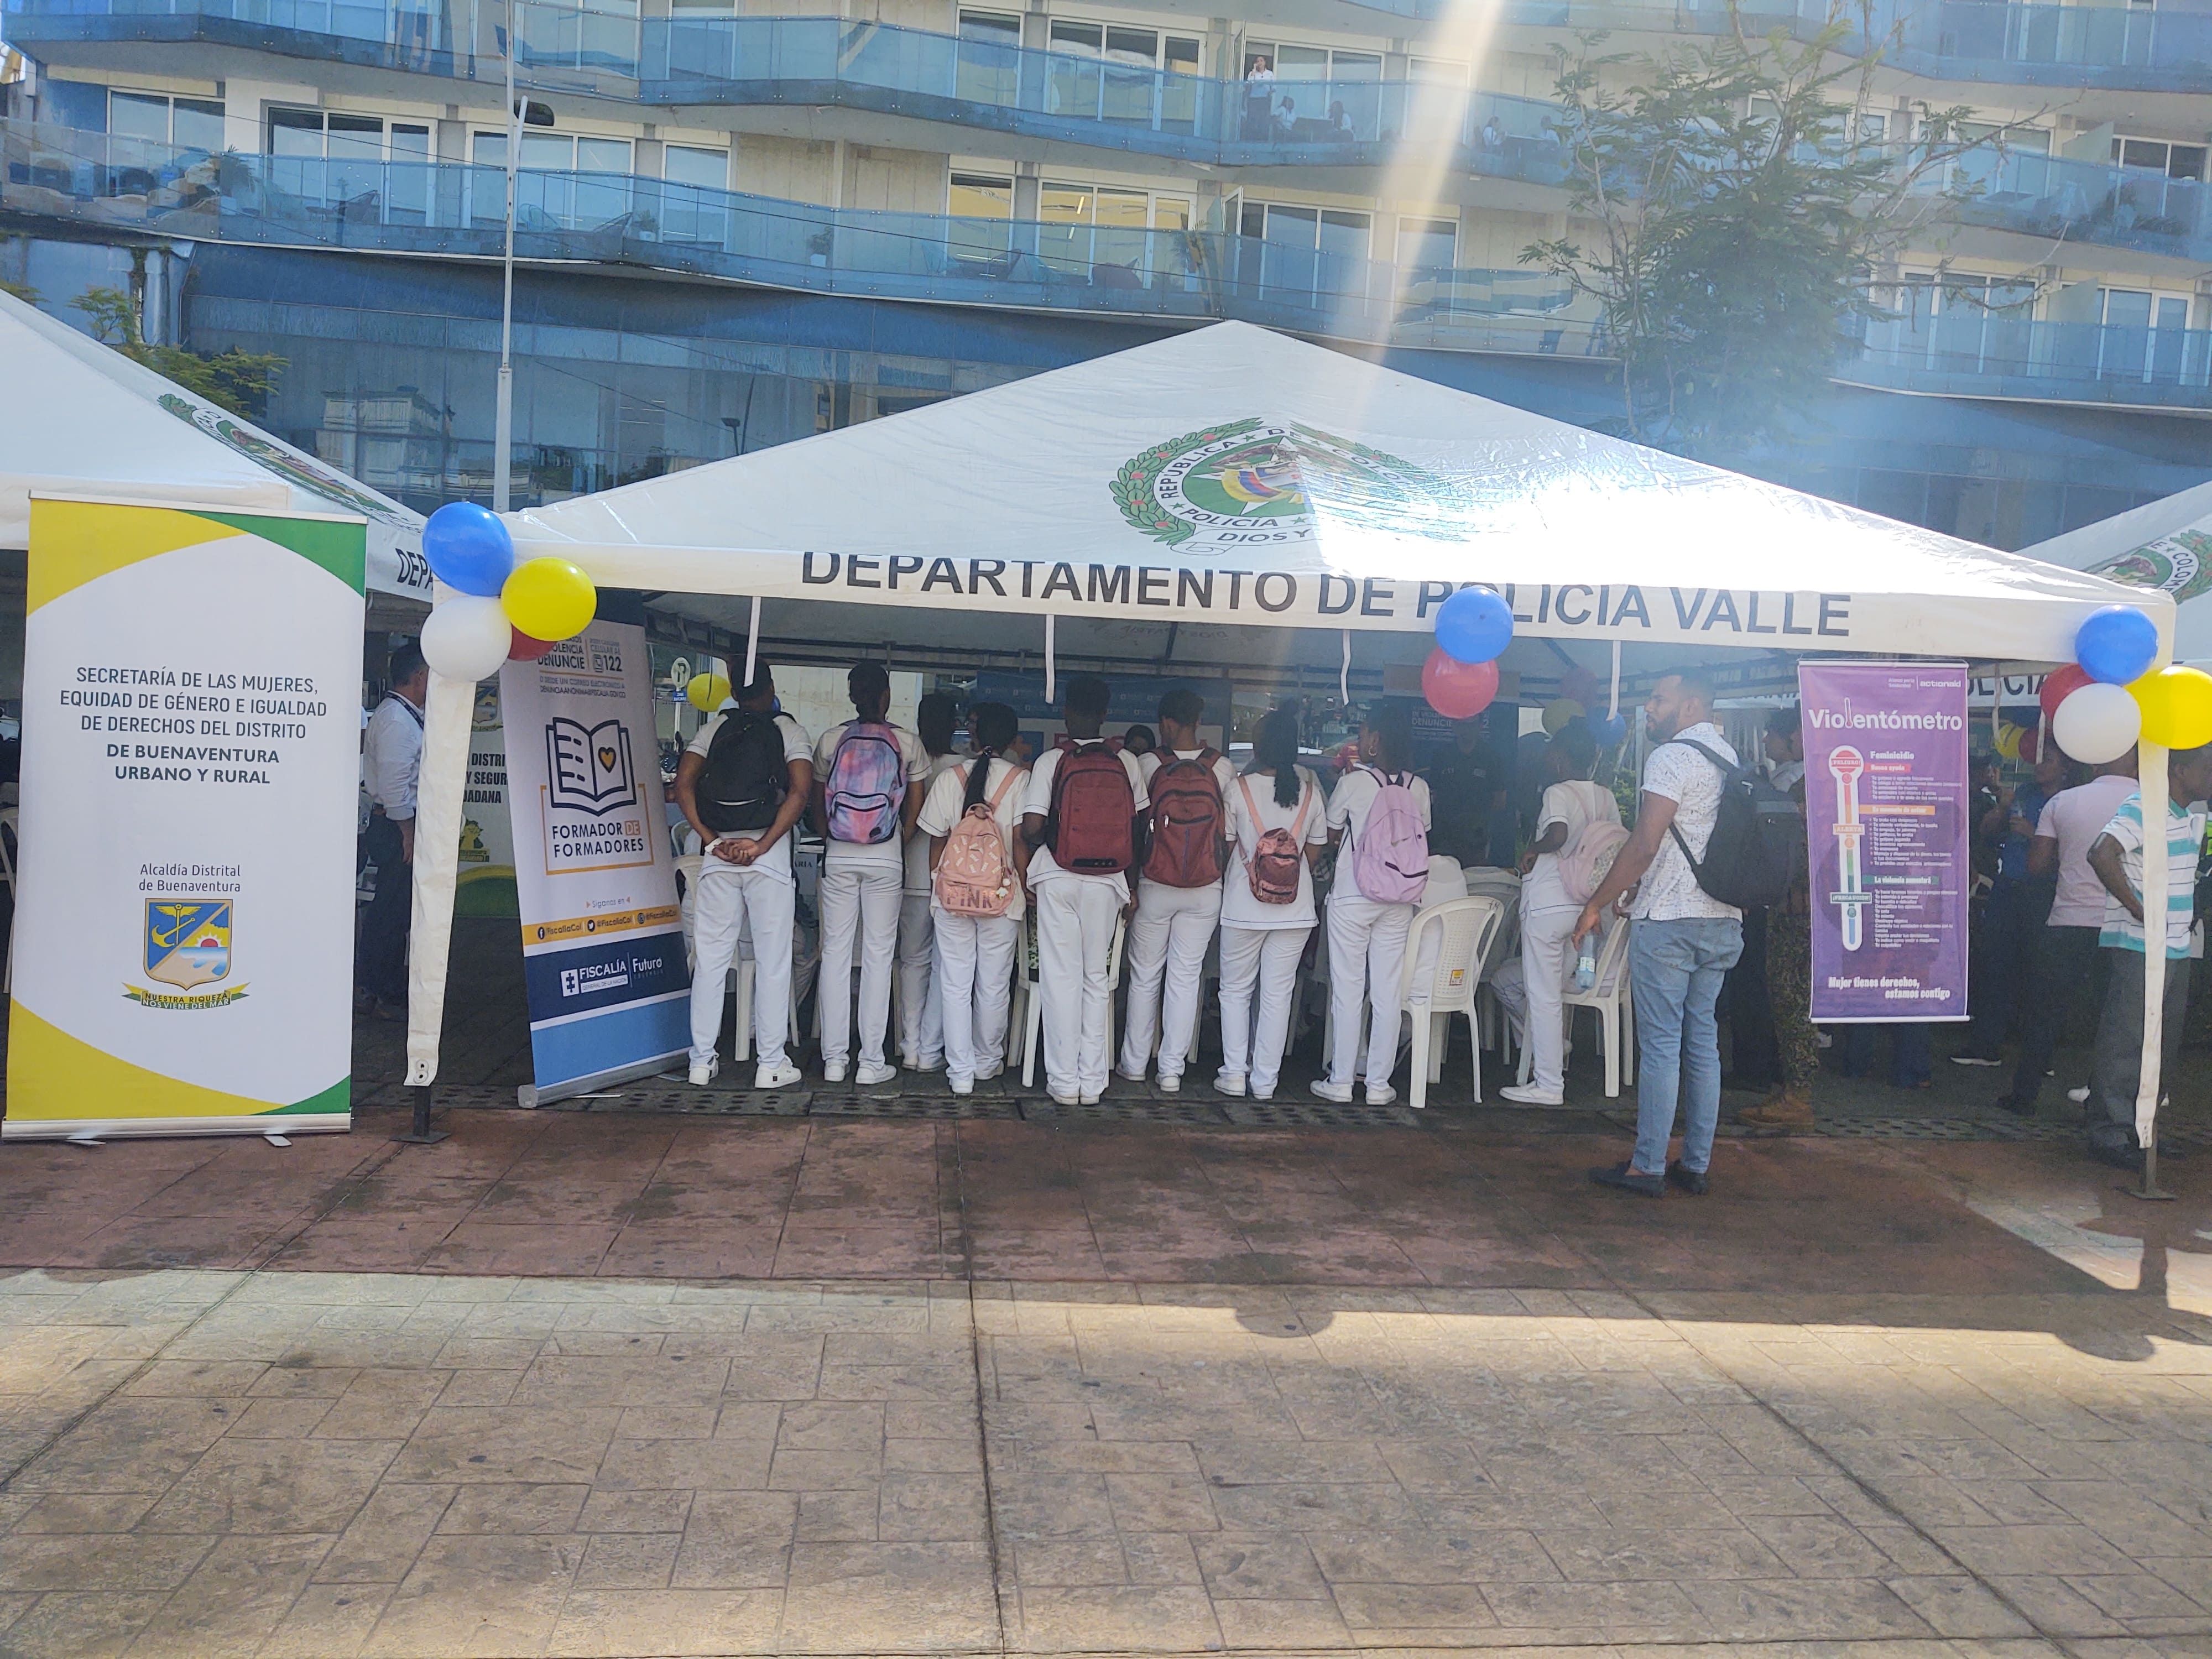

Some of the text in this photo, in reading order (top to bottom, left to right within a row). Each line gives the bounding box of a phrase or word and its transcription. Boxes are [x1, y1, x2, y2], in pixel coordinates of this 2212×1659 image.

[1178, 508, 1279, 527] POLICIA
[1217, 531, 1288, 542] DIOS
[802, 551, 1851, 638] DEPARTAMENTO DE PLICIA VALLE
[604, 655, 623, 672] 122
[76, 666, 318, 695] SECRETARÍA DE LAS MUJERES,
[60, 690, 327, 717] EQUIDAD DE GÉNERO E IGUALDAD
[1808, 697, 1963, 731] Violentómetro
[81, 715, 306, 739] DE DERECHOS DEL DISTRITO
[107, 744, 279, 763] DE BUENAVENTURA
[115, 766, 270, 784] URBANO Y RURAL
[552, 821, 640, 839] FORMADOR DE
[554, 838, 644, 858] FORMADORES
[140, 863, 241, 877] Alcaldía Distrital
[139, 878, 241, 893] de Buenaventura
[580, 958, 627, 980] FISCALÍA
[1828, 977, 1852, 990] Mujer
[1853, 976, 1879, 988] tienes
[145, 992, 228, 1003] NUESTRA RIQUEZA
[1885, 987, 1950, 1000] estamos contigo
[142, 999, 162, 1008] NOS
[209, 999, 229, 1008] MAR
